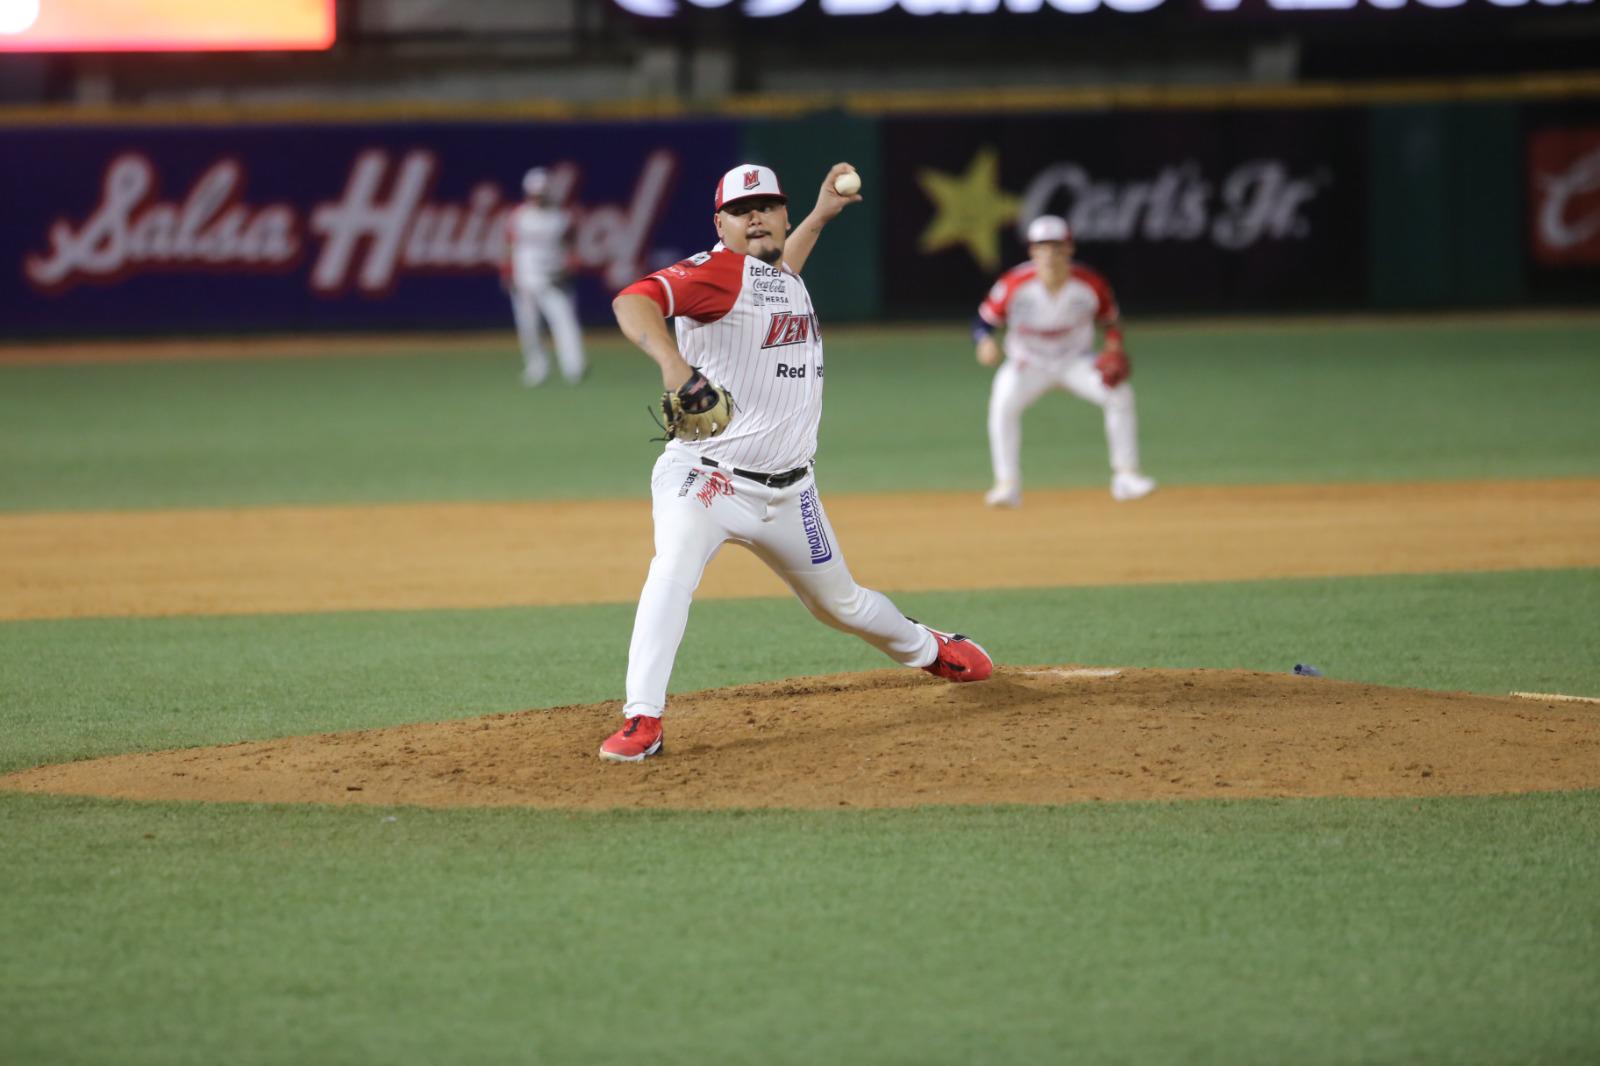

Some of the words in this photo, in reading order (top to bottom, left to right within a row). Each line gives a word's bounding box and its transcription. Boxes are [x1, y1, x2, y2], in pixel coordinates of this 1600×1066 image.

[743, 169, 761, 190] M
[25, 153, 297, 289] Salsa
[309, 147, 676, 293] Huiol
[776, 363, 806, 378] Red
